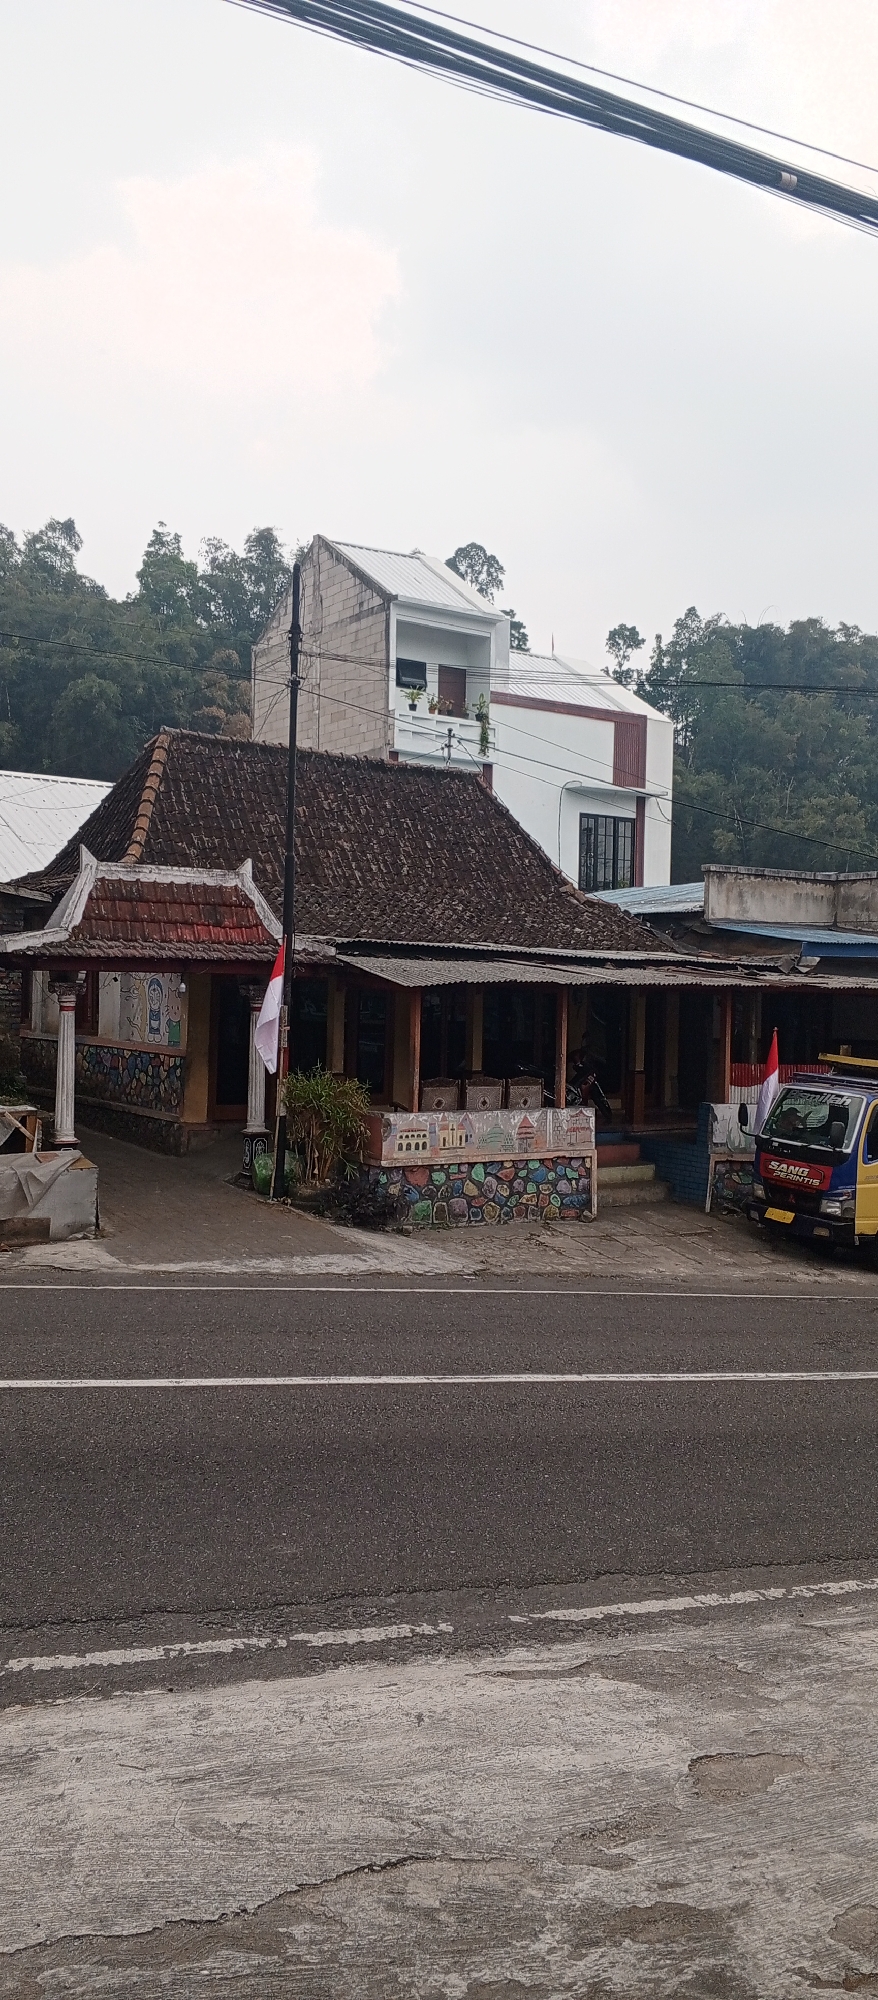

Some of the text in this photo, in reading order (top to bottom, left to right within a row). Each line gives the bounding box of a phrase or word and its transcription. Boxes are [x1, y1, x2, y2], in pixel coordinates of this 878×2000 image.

[787, 1089, 852, 1106] Bismillah
[768, 1160, 811, 1177] SANG
[773, 1170, 821, 1186] PERINTIS
